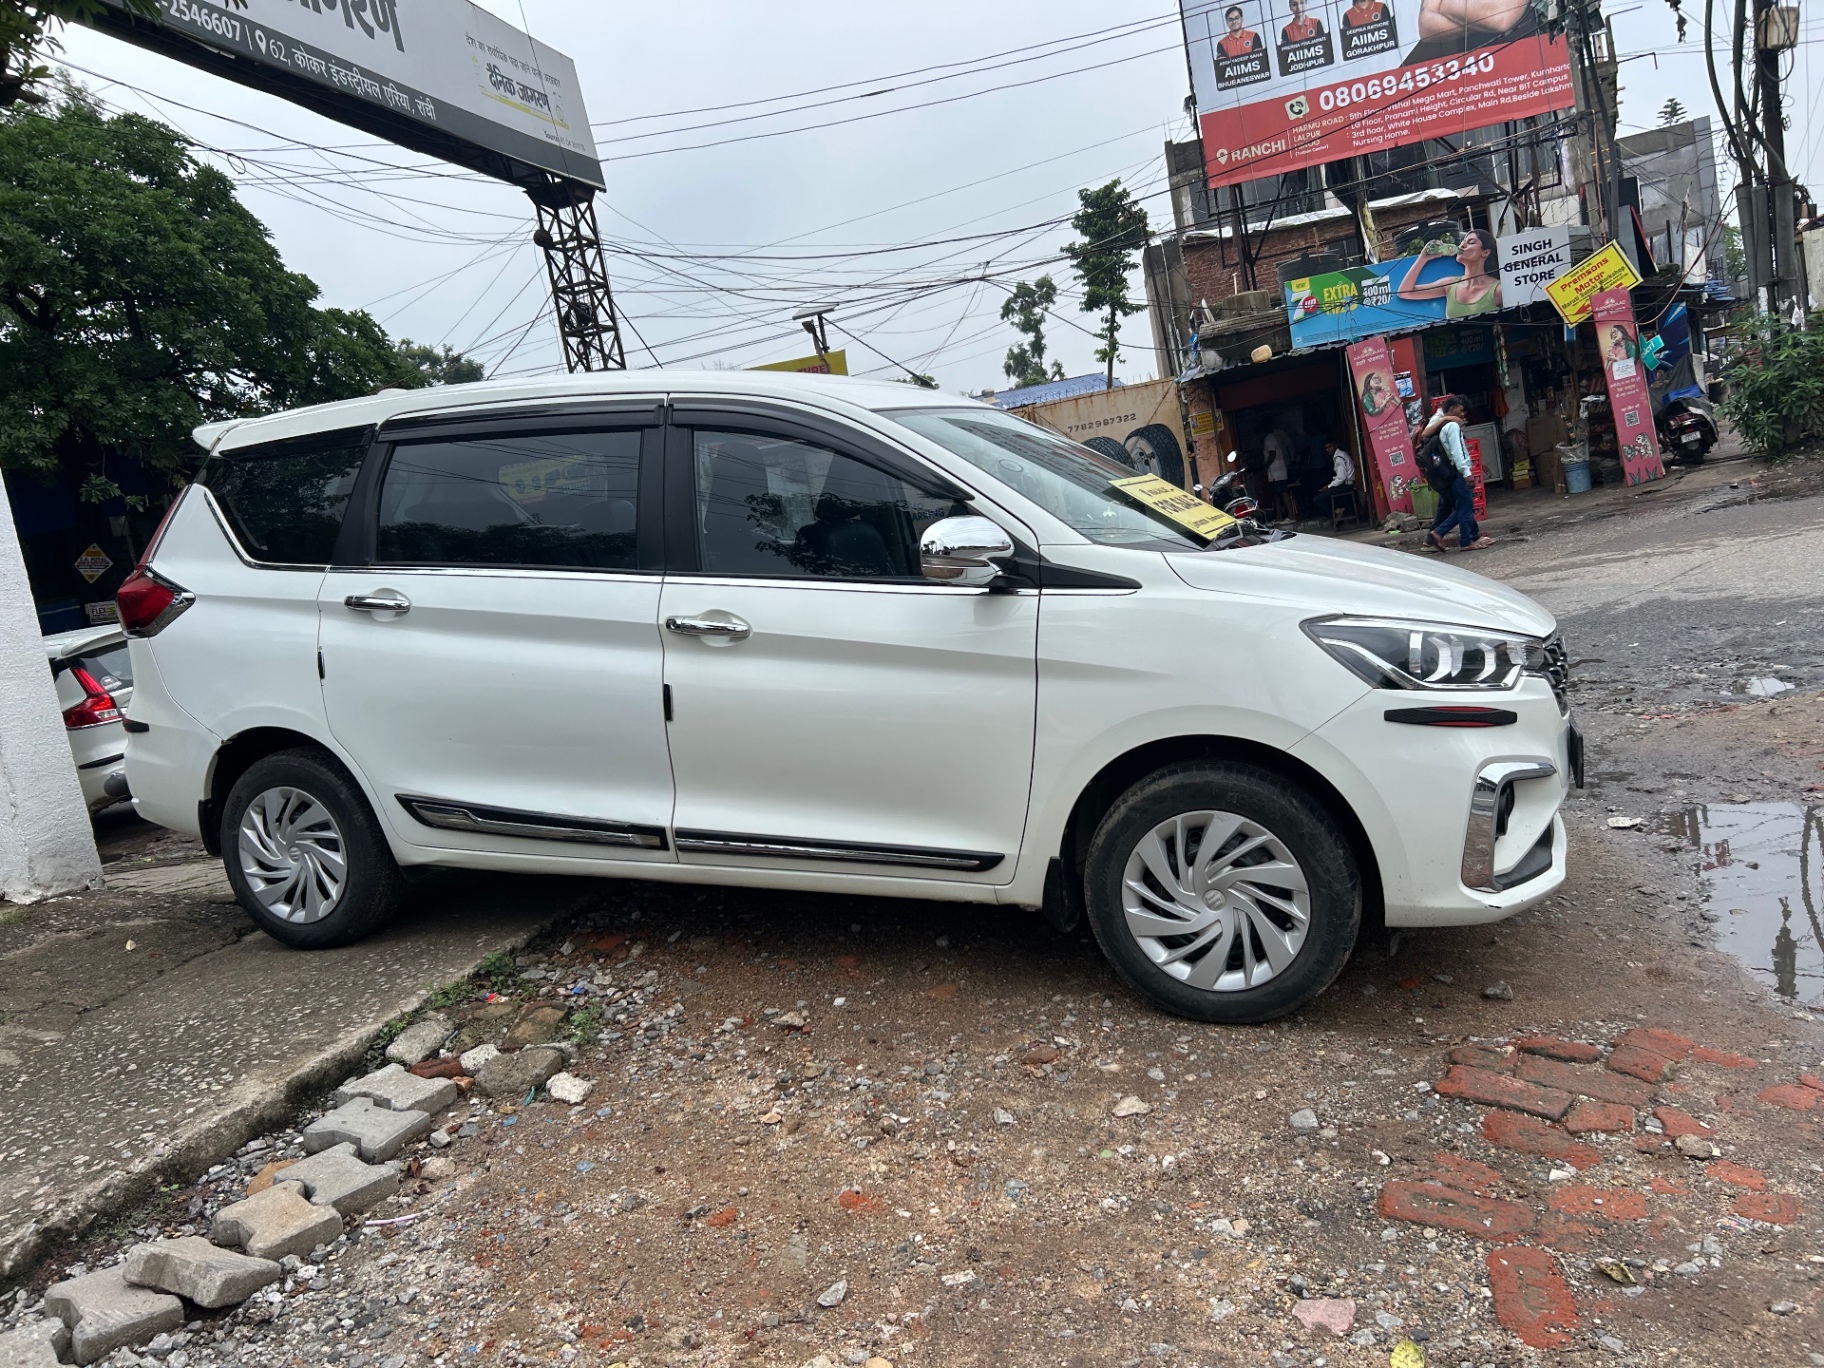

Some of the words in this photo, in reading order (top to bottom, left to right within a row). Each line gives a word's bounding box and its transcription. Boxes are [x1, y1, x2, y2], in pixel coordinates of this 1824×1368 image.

[1351, 29, 1388, 48] AIIMS
[269, 39, 291, 66] 62,
[292, 45, 328, 78] कोकर
[1287, 45, 1324, 63] AIIMS
[1346, 40, 1396, 58] GORAKHPUR
[1224, 60, 1261, 78] AIIMS
[1288, 58, 1325, 72] JODHPUR
[486, 62, 517, 97] दैनिक
[516, 81, 552, 112] जागरण
[1217, 71, 1270, 89] BHUBANESWAR
[1319, 52, 1495, 110] 08069453340
[1292, 121, 1321, 134] HARMU
[1321, 115, 1344, 127] ROAD
[1349, 109, 1363, 121] 5th
[1411, 94, 1436, 105] Mega
[1436, 89, 1457, 101] Mart,
[1458, 78, 1502, 93] Panchwati
[1502, 73, 1531, 84] Tower,
[1293, 130, 1321, 143] LALPUR
[1362, 117, 1384, 128] Floor,
[1385, 110, 1419, 122] Pranami
[1419, 101, 1449, 114] Height,
[1449, 91, 1481, 106] Circular
[1483, 89, 1497, 98] Rd,
[1497, 85, 1517, 95] Near
[1518, 82, 1531, 91] BIT
[1533, 73, 1569, 89] Campus
[1387, 119, 1411, 130] White
[1411, 113, 1437, 124] House
[1438, 105, 1477, 119] Complex,
[1478, 99, 1499, 109] Main
[1352, 135, 1383, 147] Nursing
[1383, 128, 1411, 140] Home.
[1230, 138, 1286, 162] RANCHI
[1511, 238, 1553, 256] SINGH
[1503, 252, 1564, 273] GENERAL
[1514, 269, 1556, 287] STORE
[1559, 256, 1609, 293] Premsons
[1323, 282, 1359, 302] EXTRA
[1067, 412, 1137, 433] 7782987322
